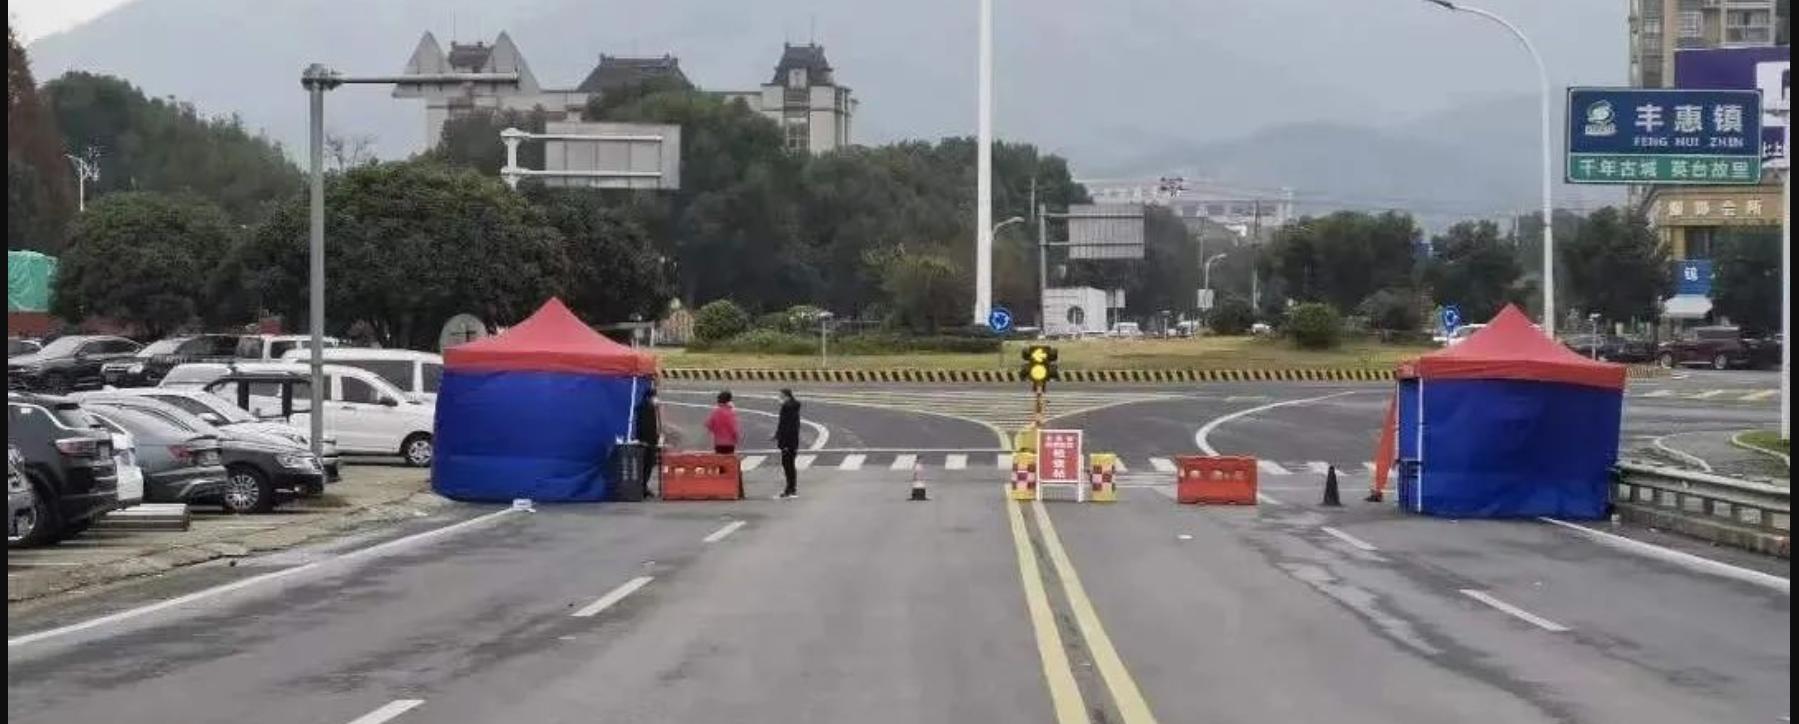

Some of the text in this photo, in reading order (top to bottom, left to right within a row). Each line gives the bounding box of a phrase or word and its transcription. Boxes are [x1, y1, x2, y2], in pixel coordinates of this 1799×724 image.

[1635, 104, 1743, 132] 丰惠镇
[1633, 137, 1668, 147] FENG
[1579, 158, 1750, 178] 千年古城 英台故里
